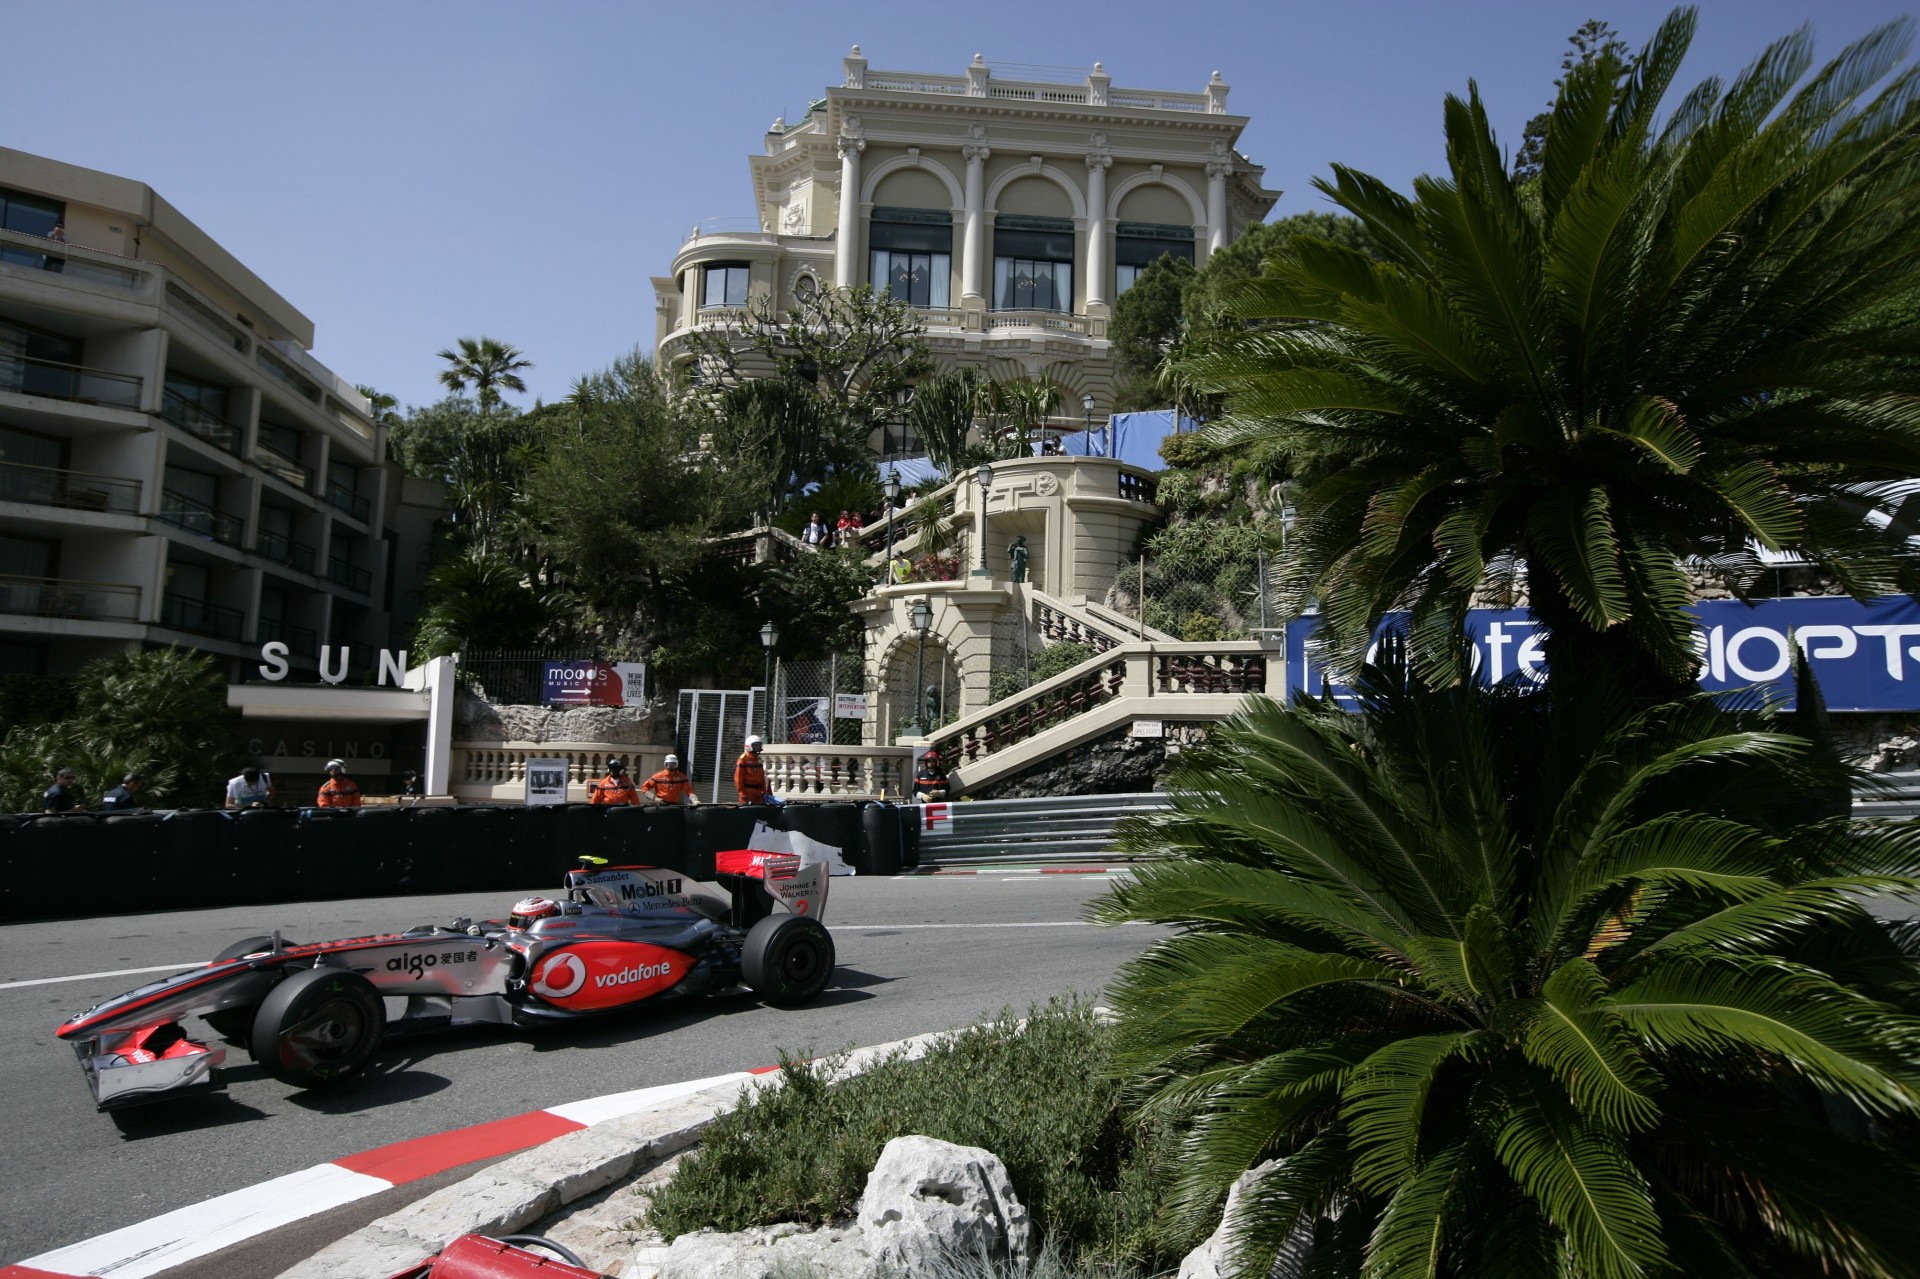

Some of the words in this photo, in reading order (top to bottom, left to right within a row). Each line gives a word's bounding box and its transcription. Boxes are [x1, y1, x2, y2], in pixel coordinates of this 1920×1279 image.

[259, 641, 407, 688] SUN
[549, 666, 608, 680] moods
[248, 738, 385, 759] CASINO
[926, 804, 948, 830] F
[586, 872, 630, 885] Santander
[780, 882, 810, 892] JOHNNIE
[620, 880, 664, 900] Mobil
[781, 891, 810, 899] WALKER
[386, 952, 437, 981] aigo
[440, 950, 479, 965] 爱国者
[594, 961, 672, 988] vodafone
